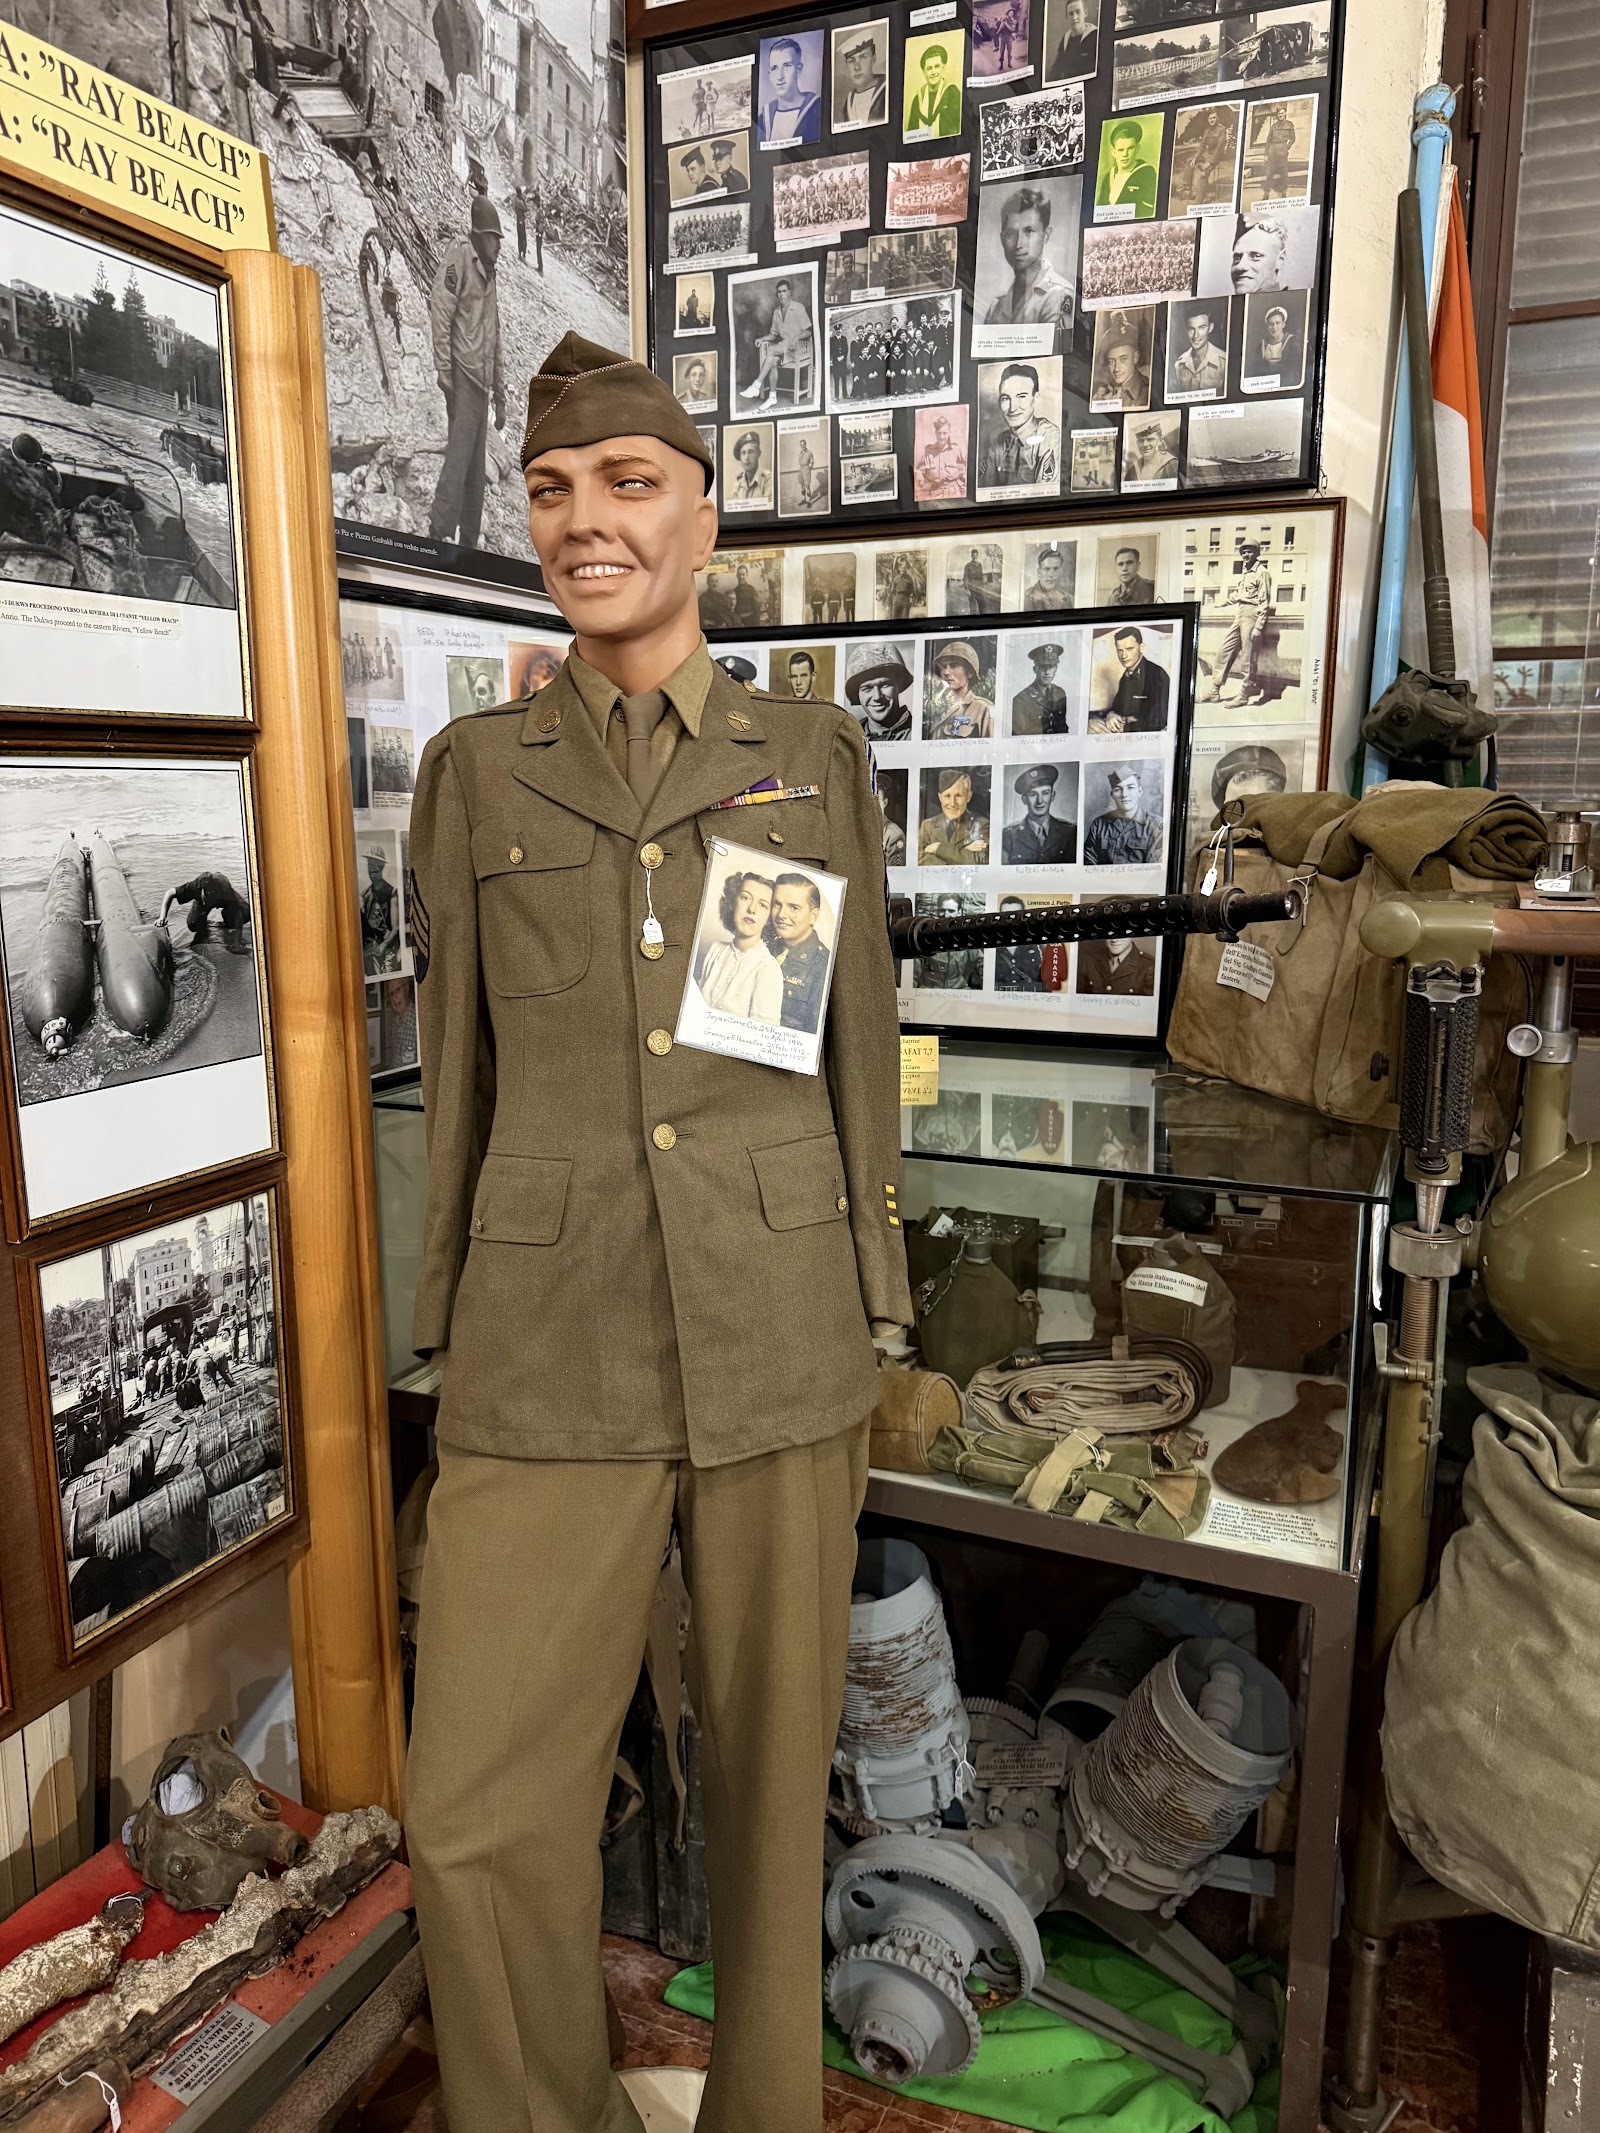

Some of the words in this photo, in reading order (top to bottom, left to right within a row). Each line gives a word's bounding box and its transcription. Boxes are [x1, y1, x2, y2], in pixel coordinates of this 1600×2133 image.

[133, 97, 250, 180] BEACH”
[126, 155, 244, 235] BEACH”
[30, 603, 62, 611] PROCEDONO
[34, 616, 53, 624] Dukws
[1154, 1273, 1177, 1284] italiana
[1178, 1278, 1195, 1288] dono
[1195, 1283, 1206, 1292] del
[173, 2061, 199, 2084] RIFLE
